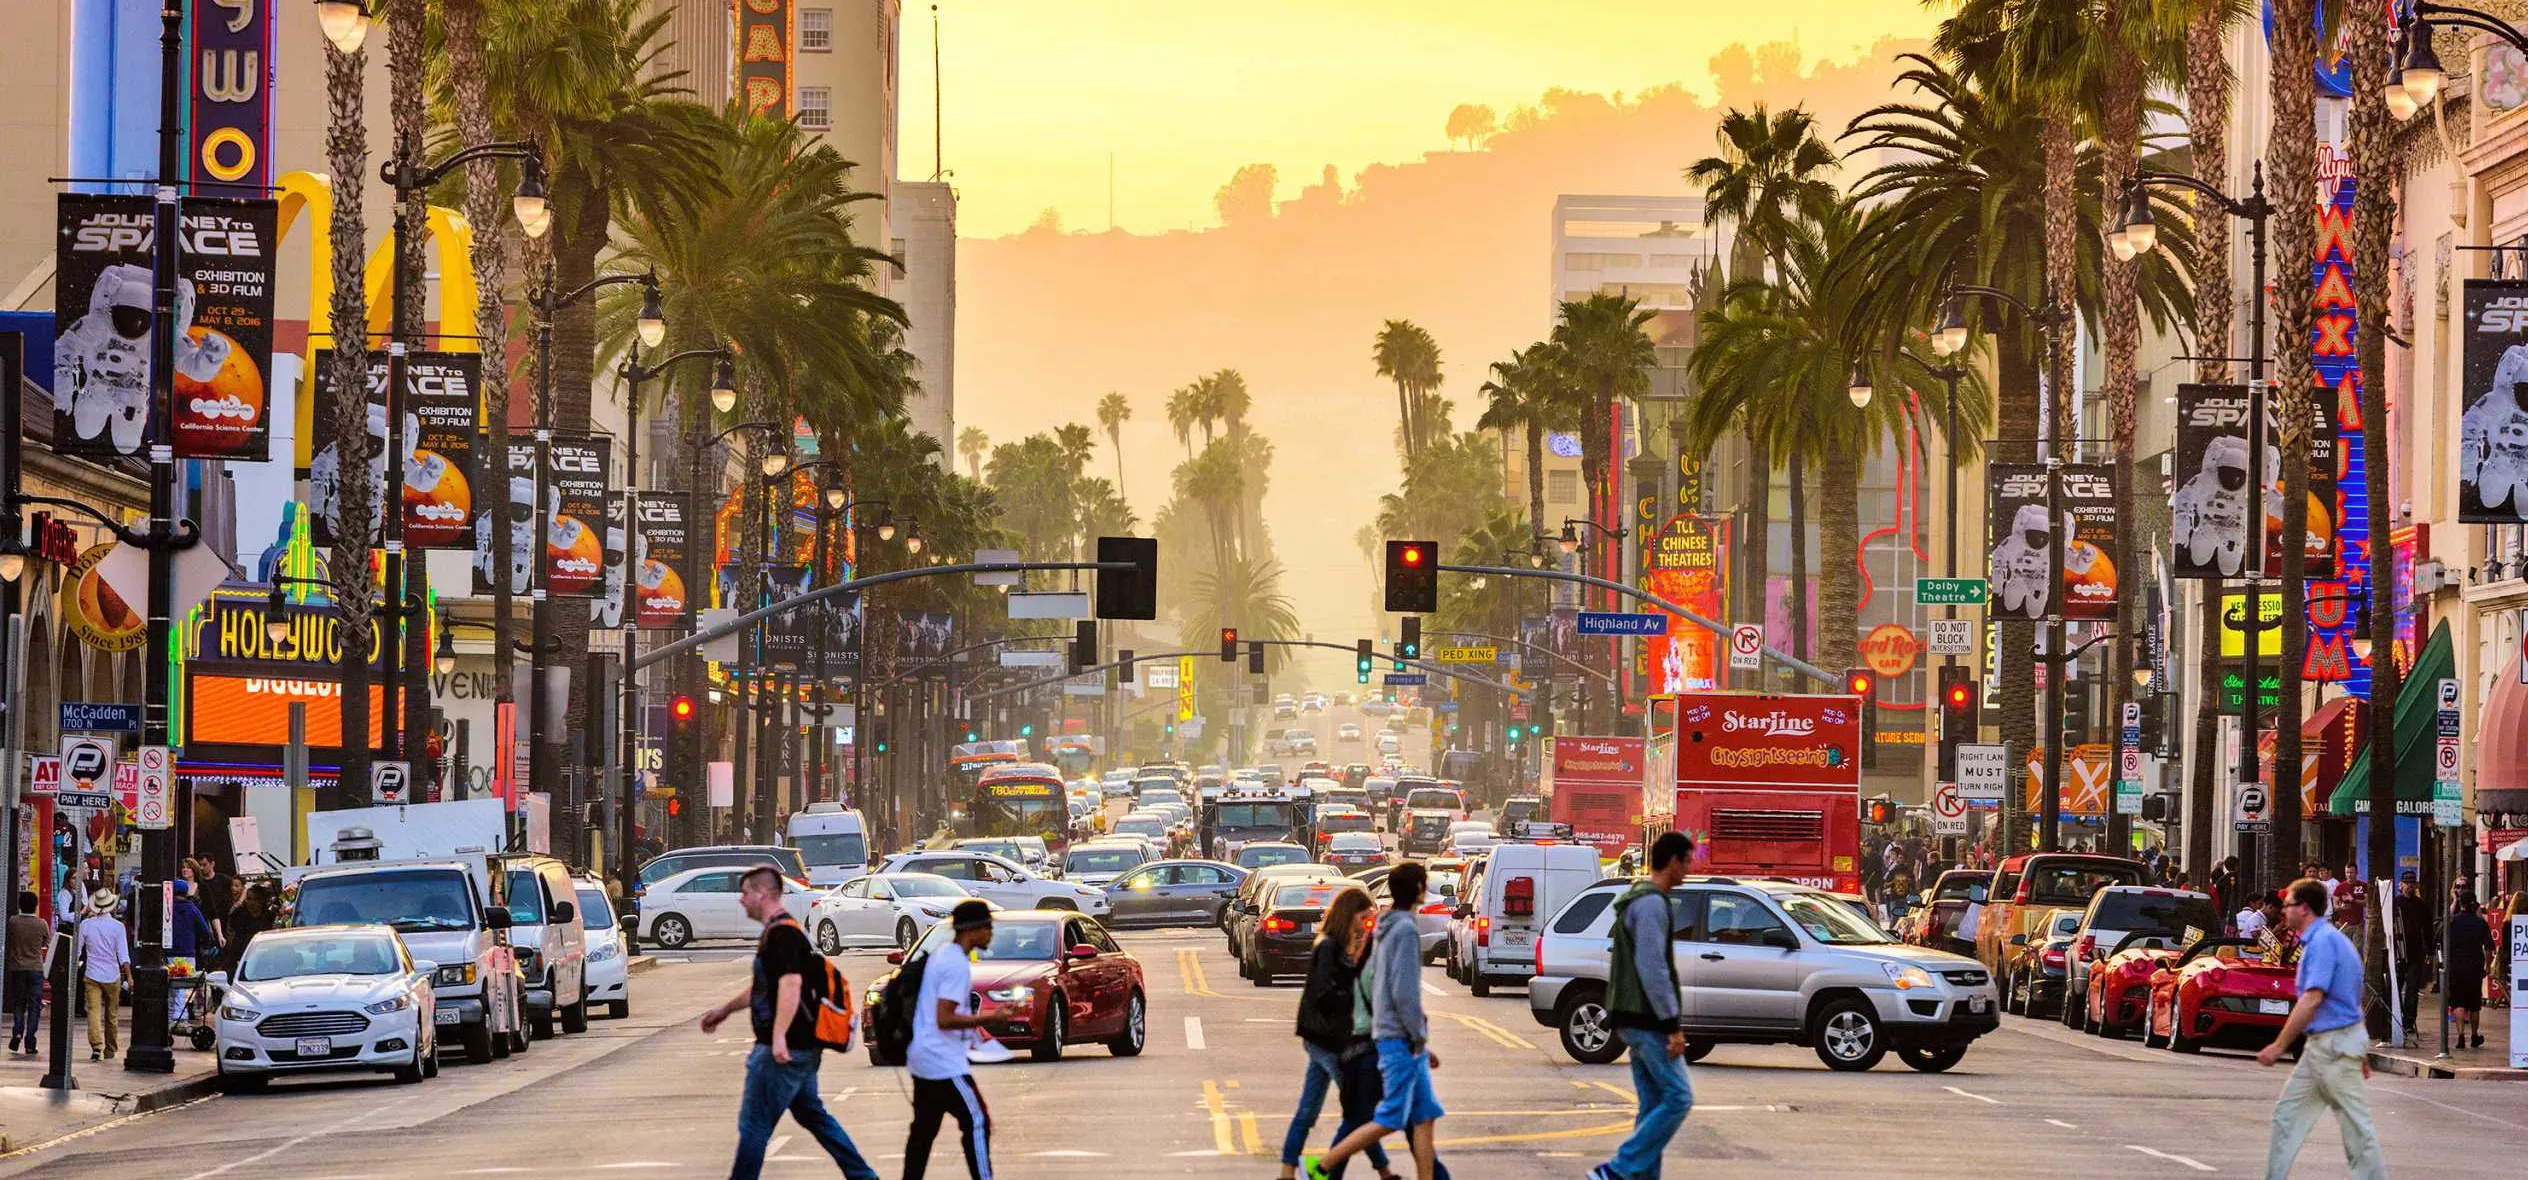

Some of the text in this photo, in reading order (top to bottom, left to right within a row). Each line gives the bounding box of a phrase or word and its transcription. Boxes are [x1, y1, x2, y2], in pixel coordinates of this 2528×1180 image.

[72, 227, 261, 257] SPACE
[195, 270, 265, 284] EXHIBITION
[2313, 203, 2356, 356] WAX
[196, 283, 263, 297] & 3D FILM
[231, 307, 246, 315] 29
[200, 316, 221, 325] MAY
[236, 317, 261, 326] 2016
[418, 406, 472, 416] EXHIBITION
[180, 422, 265, 433] California Science Center
[430, 417, 445, 426] 3D
[447, 417, 470, 427] FILM
[560, 480, 603, 489] EXHIBITION
[583, 489, 602, 497] FILM
[2000, 483, 2113, 498] SPACE
[2073, 507, 2116, 515] EXHIBITION
[1675, 520, 1695, 534] TCL
[1662, 537, 1708, 551] CHINESE
[1658, 553, 1713, 568] THEATRES
[1927, 581, 1960, 592] Dolby
[1921, 593, 1966, 602] Theatre
[1585, 616, 1660, 632] Highland Av
[1935, 622, 1967, 633] DO NOT
[78, 623, 115, 650] Since
[1937, 633, 1965, 645] BLOCK
[1931, 645, 1971, 653] INTERSECTION
[1442, 650, 1464, 659] PED
[1467, 650, 1493, 660] XING
[1733, 655, 1759, 666] ON RED
[1181, 662, 1192, 713] INN
[63, 705, 126, 720] McCadden
[63, 719, 83, 729] 1700
[86, 720, 94, 729] N
[1959, 752, 2003, 761] RIGHT LAN
[1965, 767, 2003, 777] MUST
[1959, 783, 2003, 791] TURN RIGH
[61, 795, 107, 807] PAY HERE
[1937, 821, 1966, 831] ON RED
[2353, 885, 2364, 894] 22
